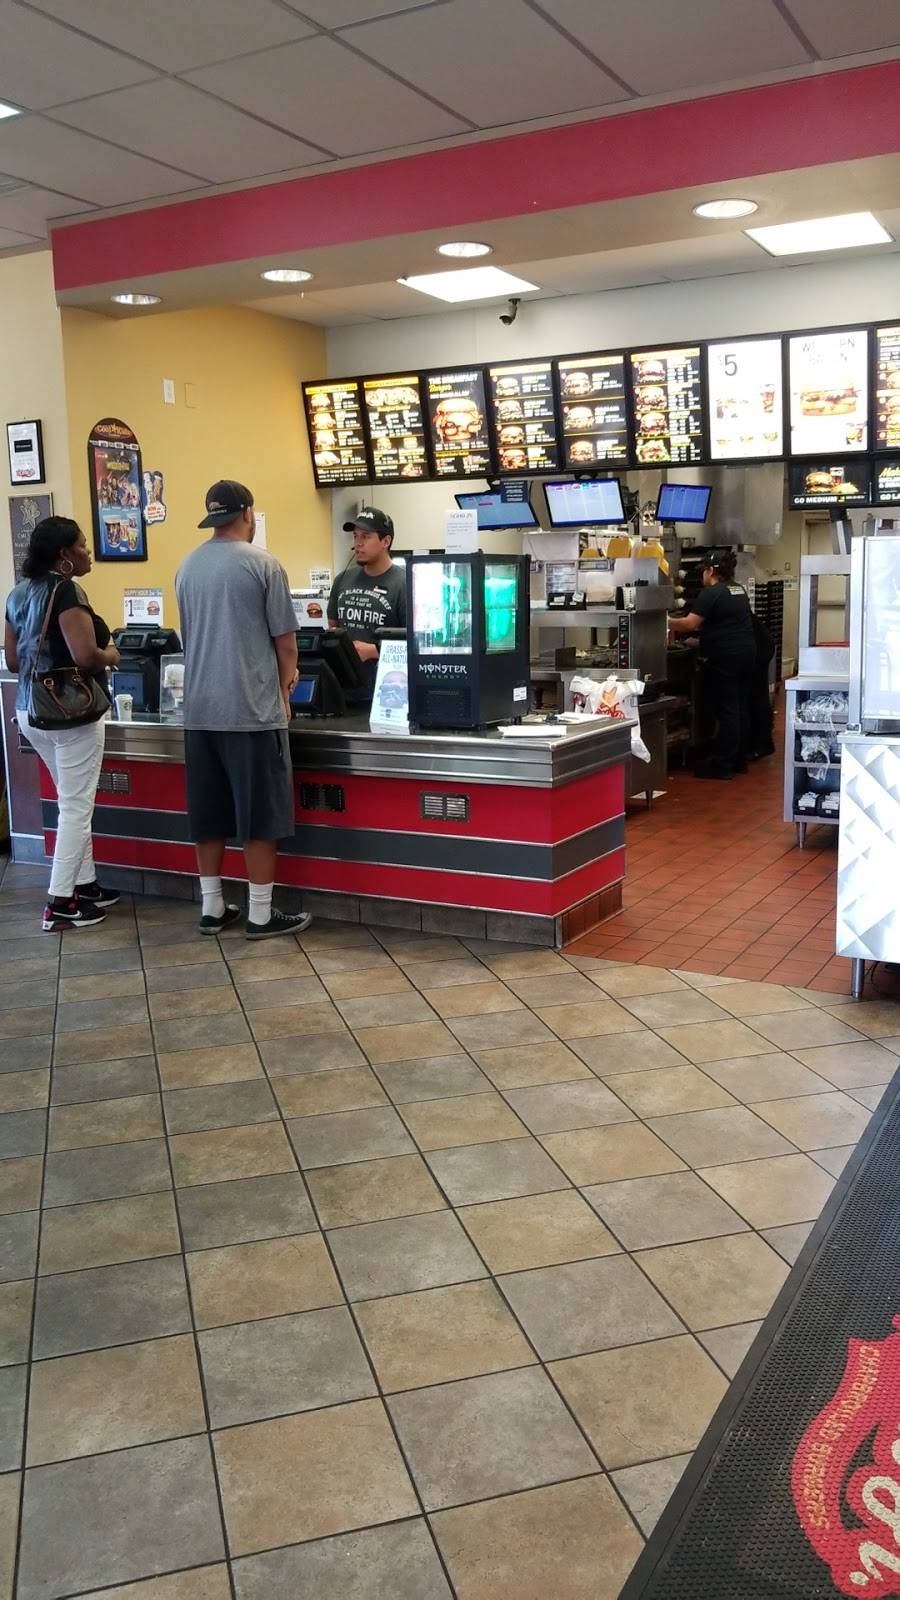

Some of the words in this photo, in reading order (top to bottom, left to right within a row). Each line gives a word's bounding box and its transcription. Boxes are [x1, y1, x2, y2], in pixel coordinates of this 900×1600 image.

[364, 589, 380, 598] ANGUS
[379, 596, 392, 610] BEEF
[346, 607, 361, 621] ON
[364, 610, 386, 625] FIRE
[419, 663, 467, 674] MONSTER
